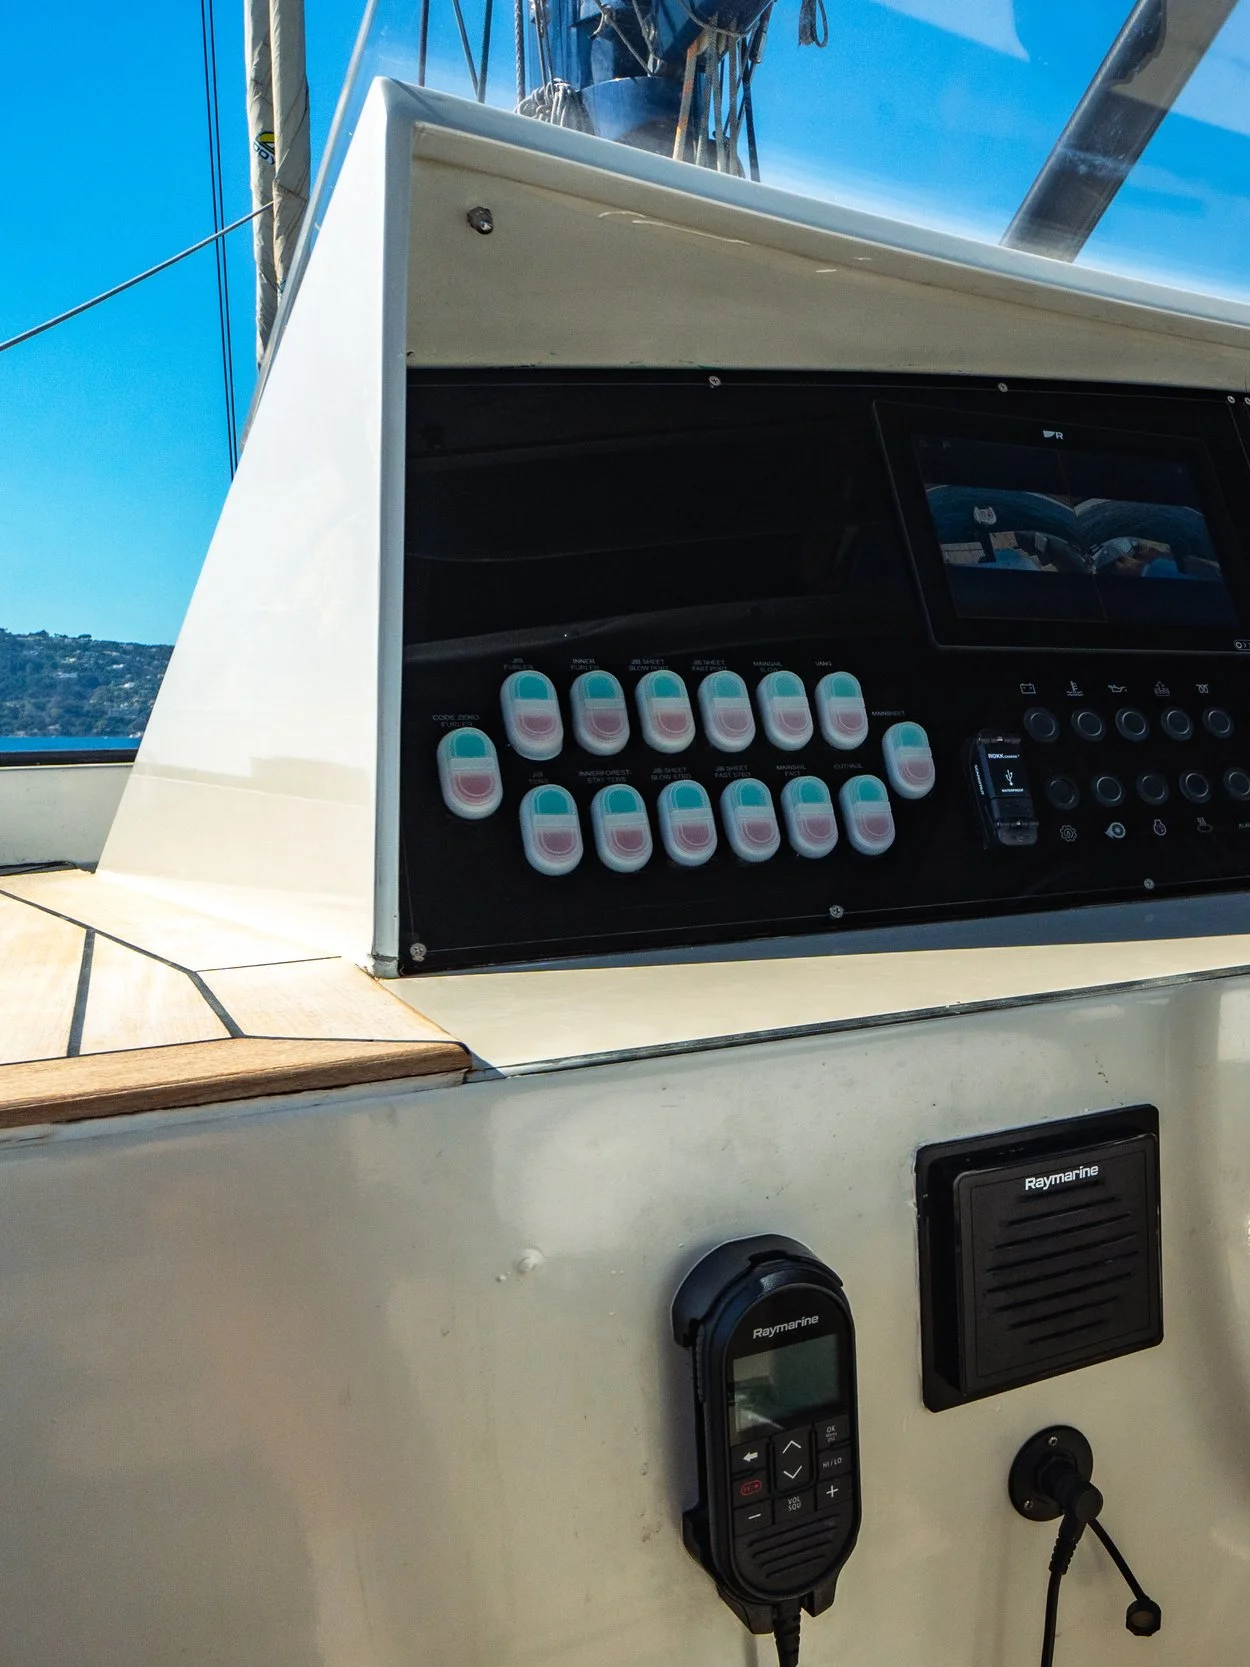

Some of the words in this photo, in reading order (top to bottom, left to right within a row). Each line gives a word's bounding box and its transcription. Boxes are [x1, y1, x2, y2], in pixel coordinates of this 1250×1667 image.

[1025, 1165, 1099, 1191] Raymarine
[752, 1315, 819, 1340] Raymarine
[788, 1496, 800, 1504] VOL
